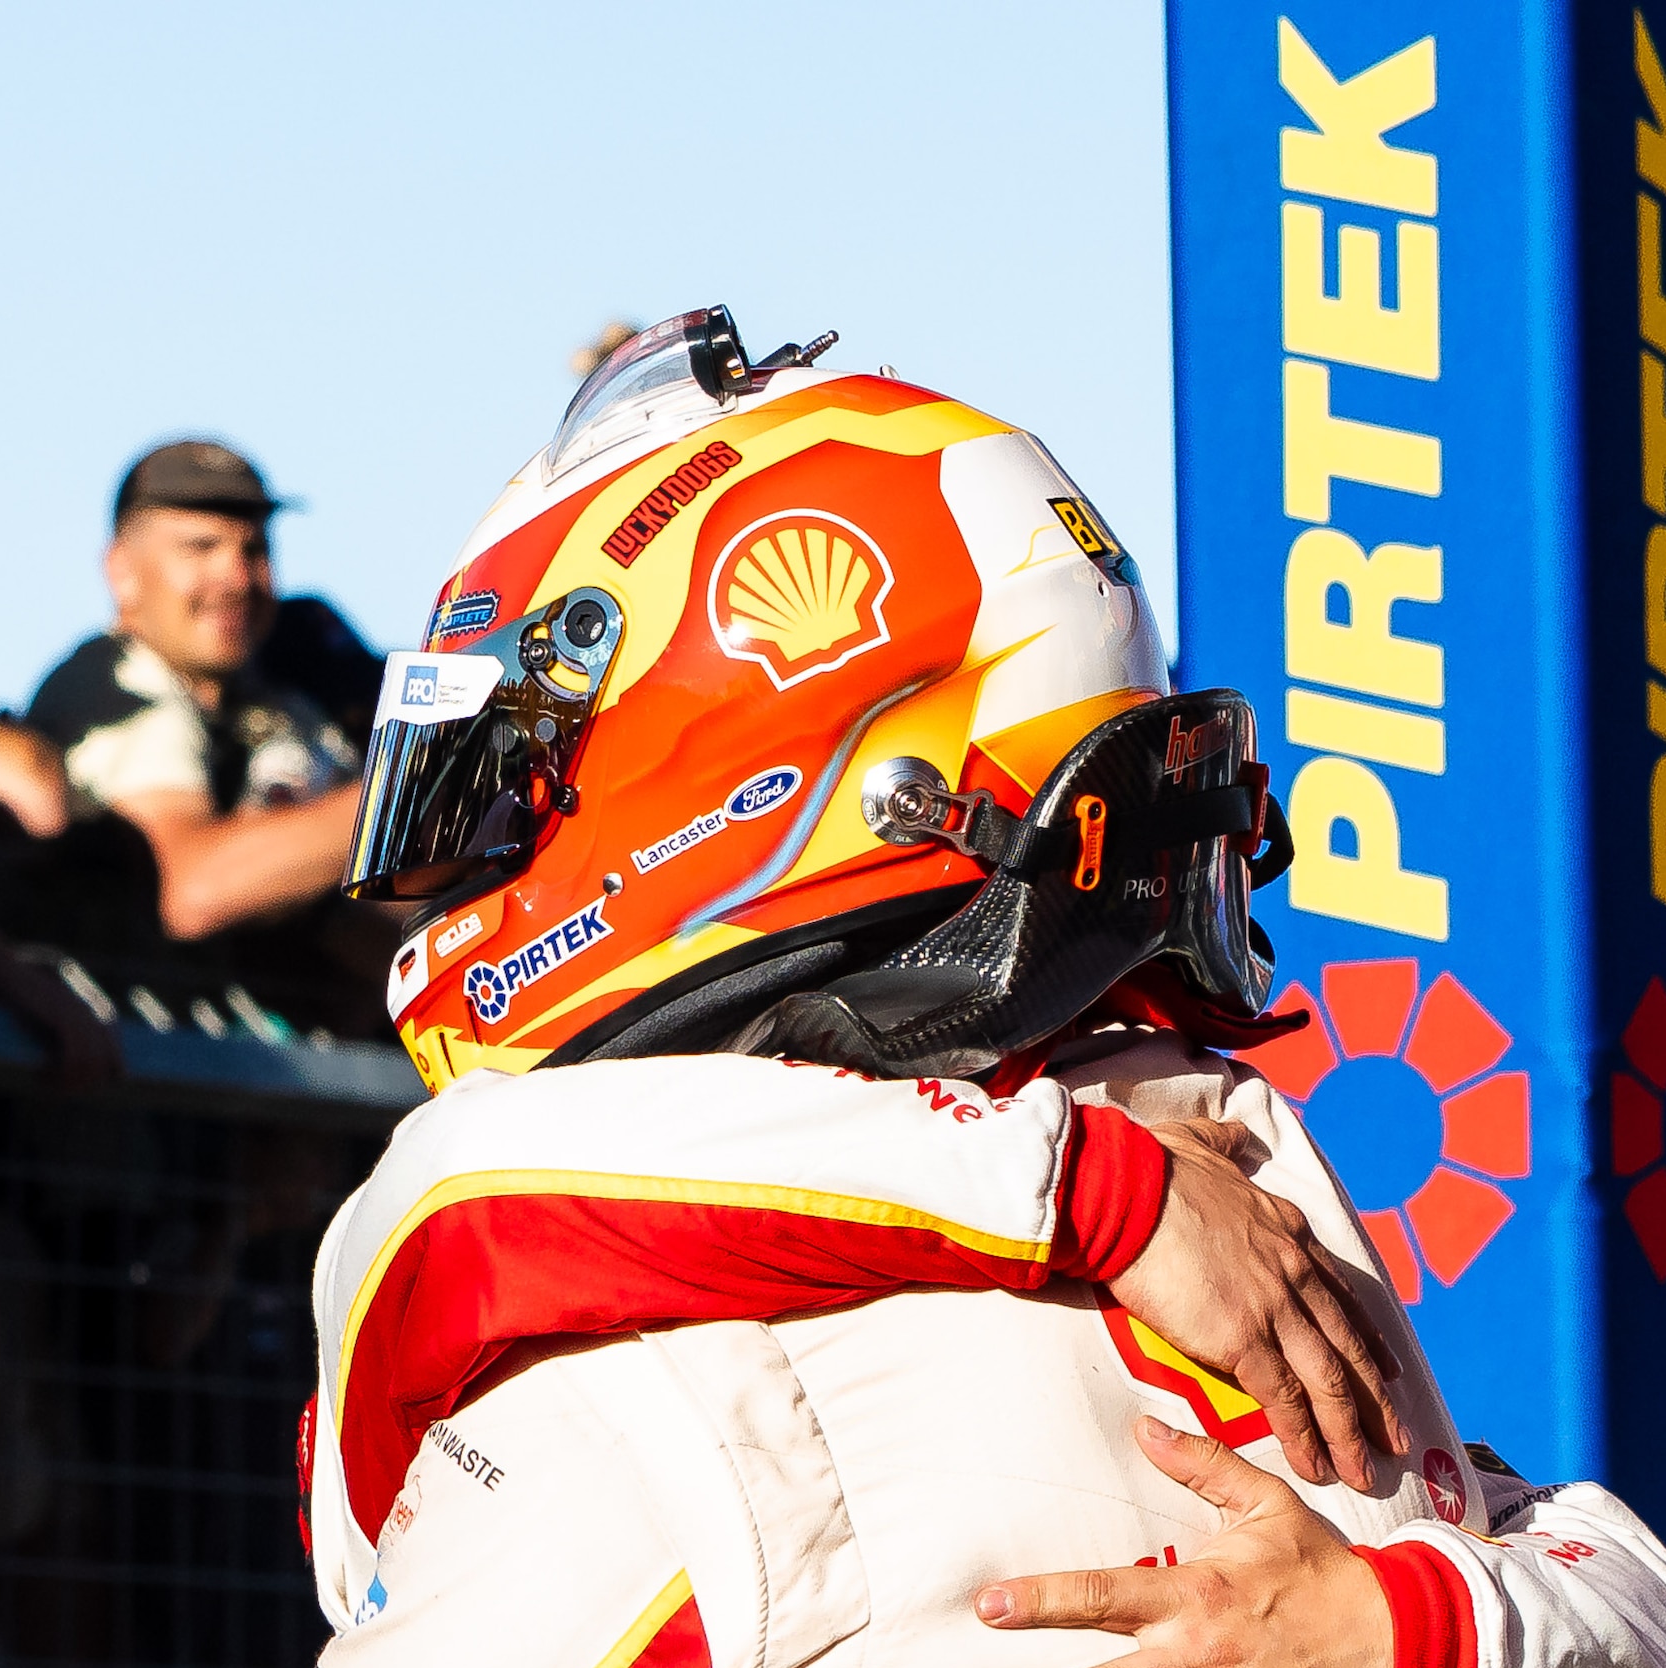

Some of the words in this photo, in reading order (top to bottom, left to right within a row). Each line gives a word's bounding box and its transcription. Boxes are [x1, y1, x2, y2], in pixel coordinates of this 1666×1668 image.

[1277, 14, 1450, 944] PIRTEK
[636, 813, 723, 869] Lancaster
[742, 777, 786, 812] Ford
[1123, 876, 1167, 900] PRO
[503, 905, 607, 991] PIRTEK
[443, 1429, 505, 1492] WASTE
